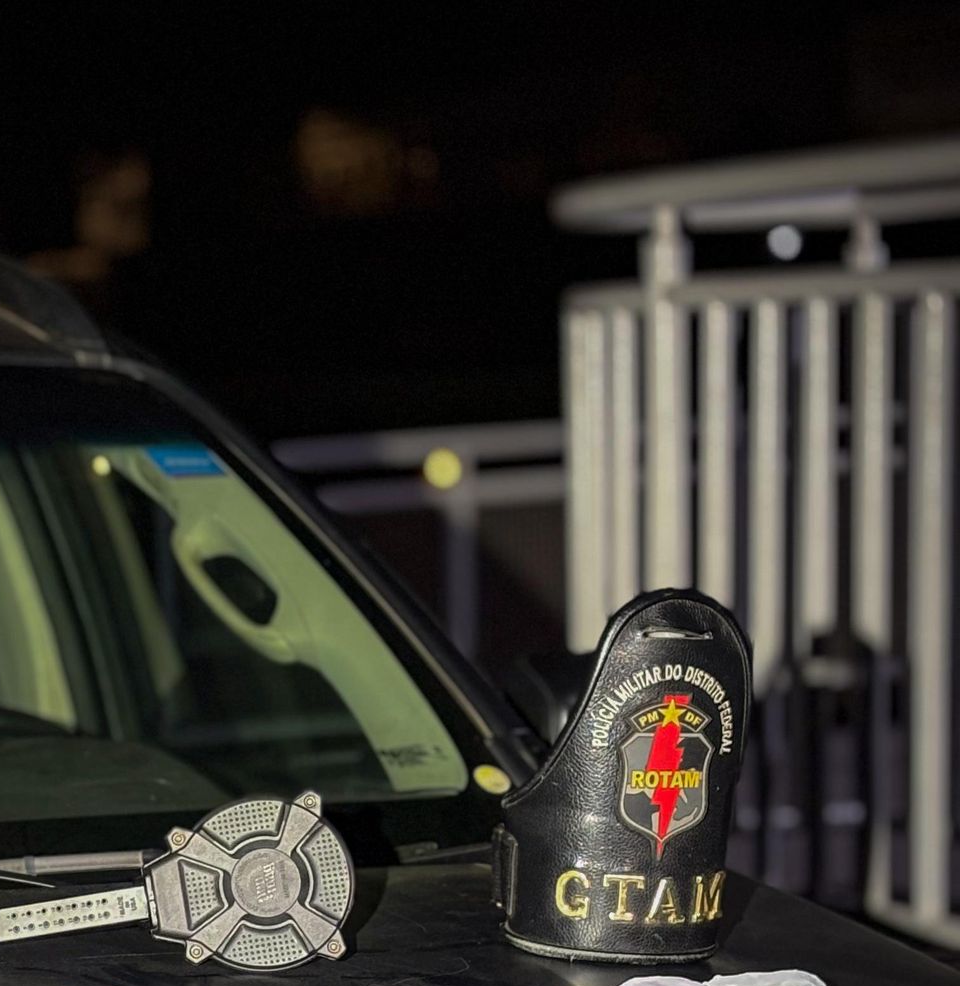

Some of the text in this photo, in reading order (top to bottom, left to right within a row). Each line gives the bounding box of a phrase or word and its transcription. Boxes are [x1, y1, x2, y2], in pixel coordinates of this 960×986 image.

[590, 664, 733, 756] POLÍCIA MILITAR DO DISTRITO FEDERAL
[638, 711, 703, 727] PM DF
[630, 769, 702, 789] ROTAM
[555, 870, 726, 924] GTAM
